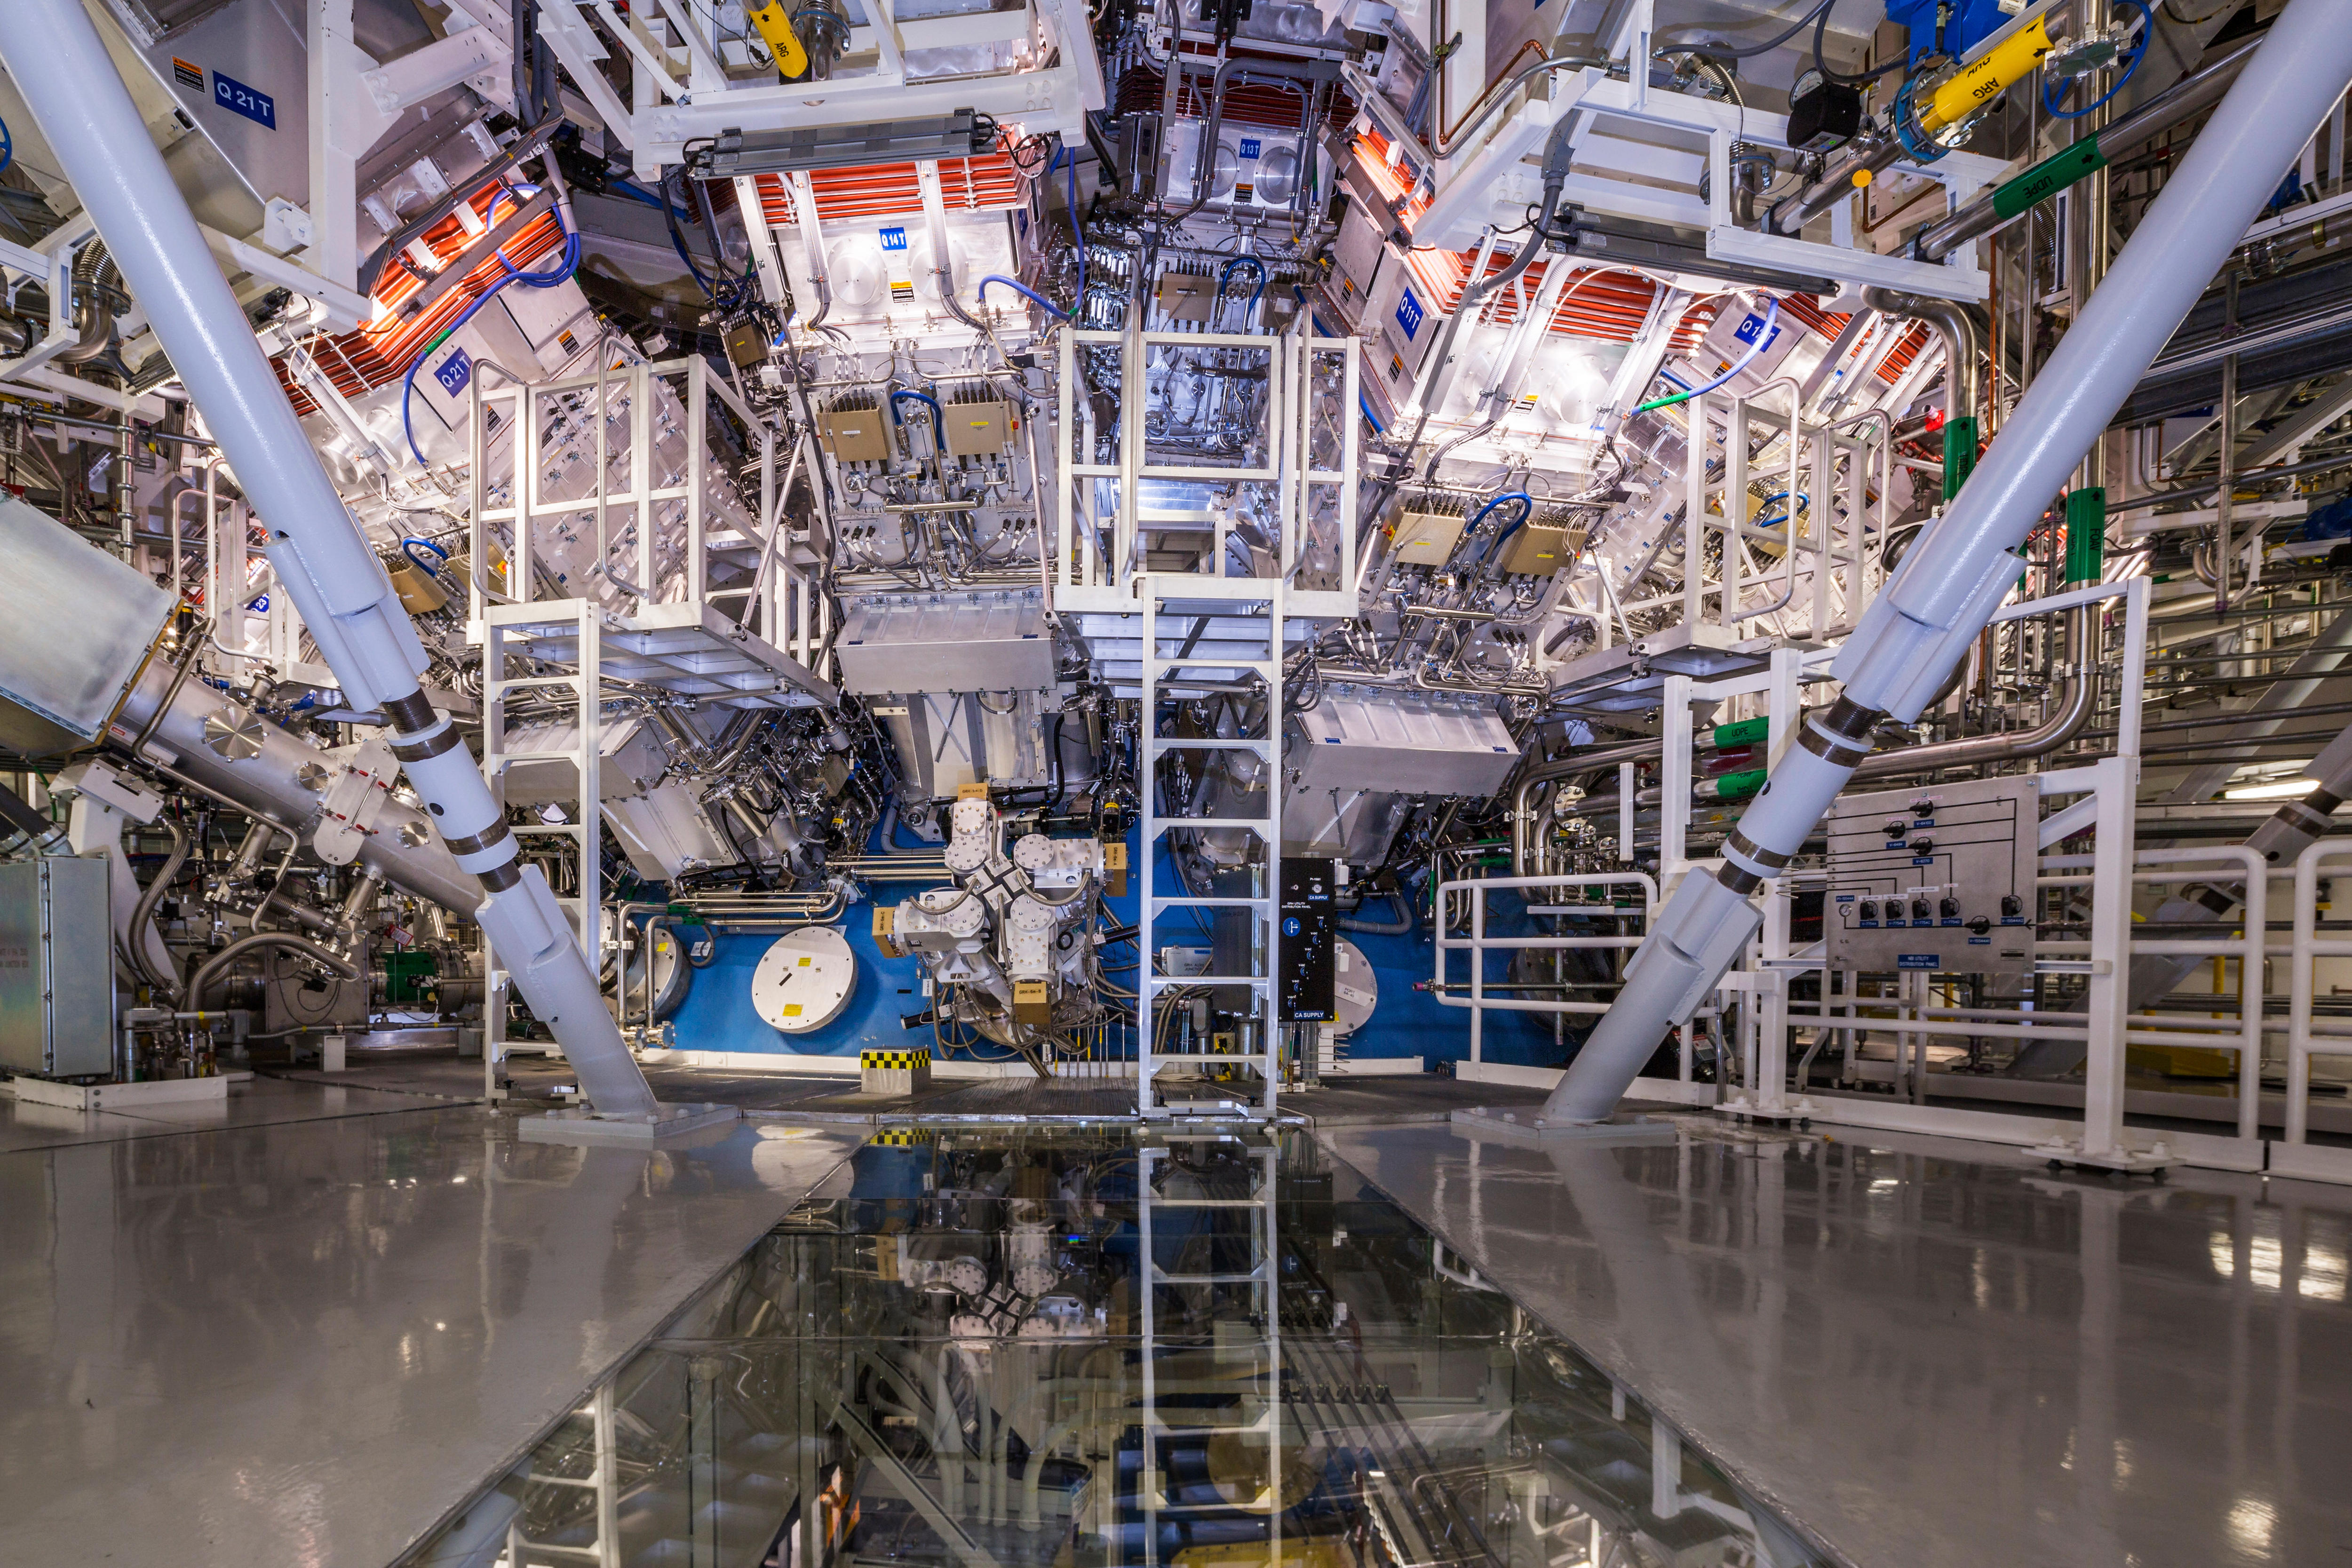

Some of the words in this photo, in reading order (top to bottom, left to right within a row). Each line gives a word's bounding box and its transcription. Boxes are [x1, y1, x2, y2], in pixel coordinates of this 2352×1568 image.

[774, 42, 789, 57] ARG
[217, 82, 231, 100] Q
[1972, 77, 2000, 99] ARG
[2023, 175, 2053, 199] UDPE
[2089, 528, 2101, 551] FOAV
[1732, 726, 1749, 737] UDPE
